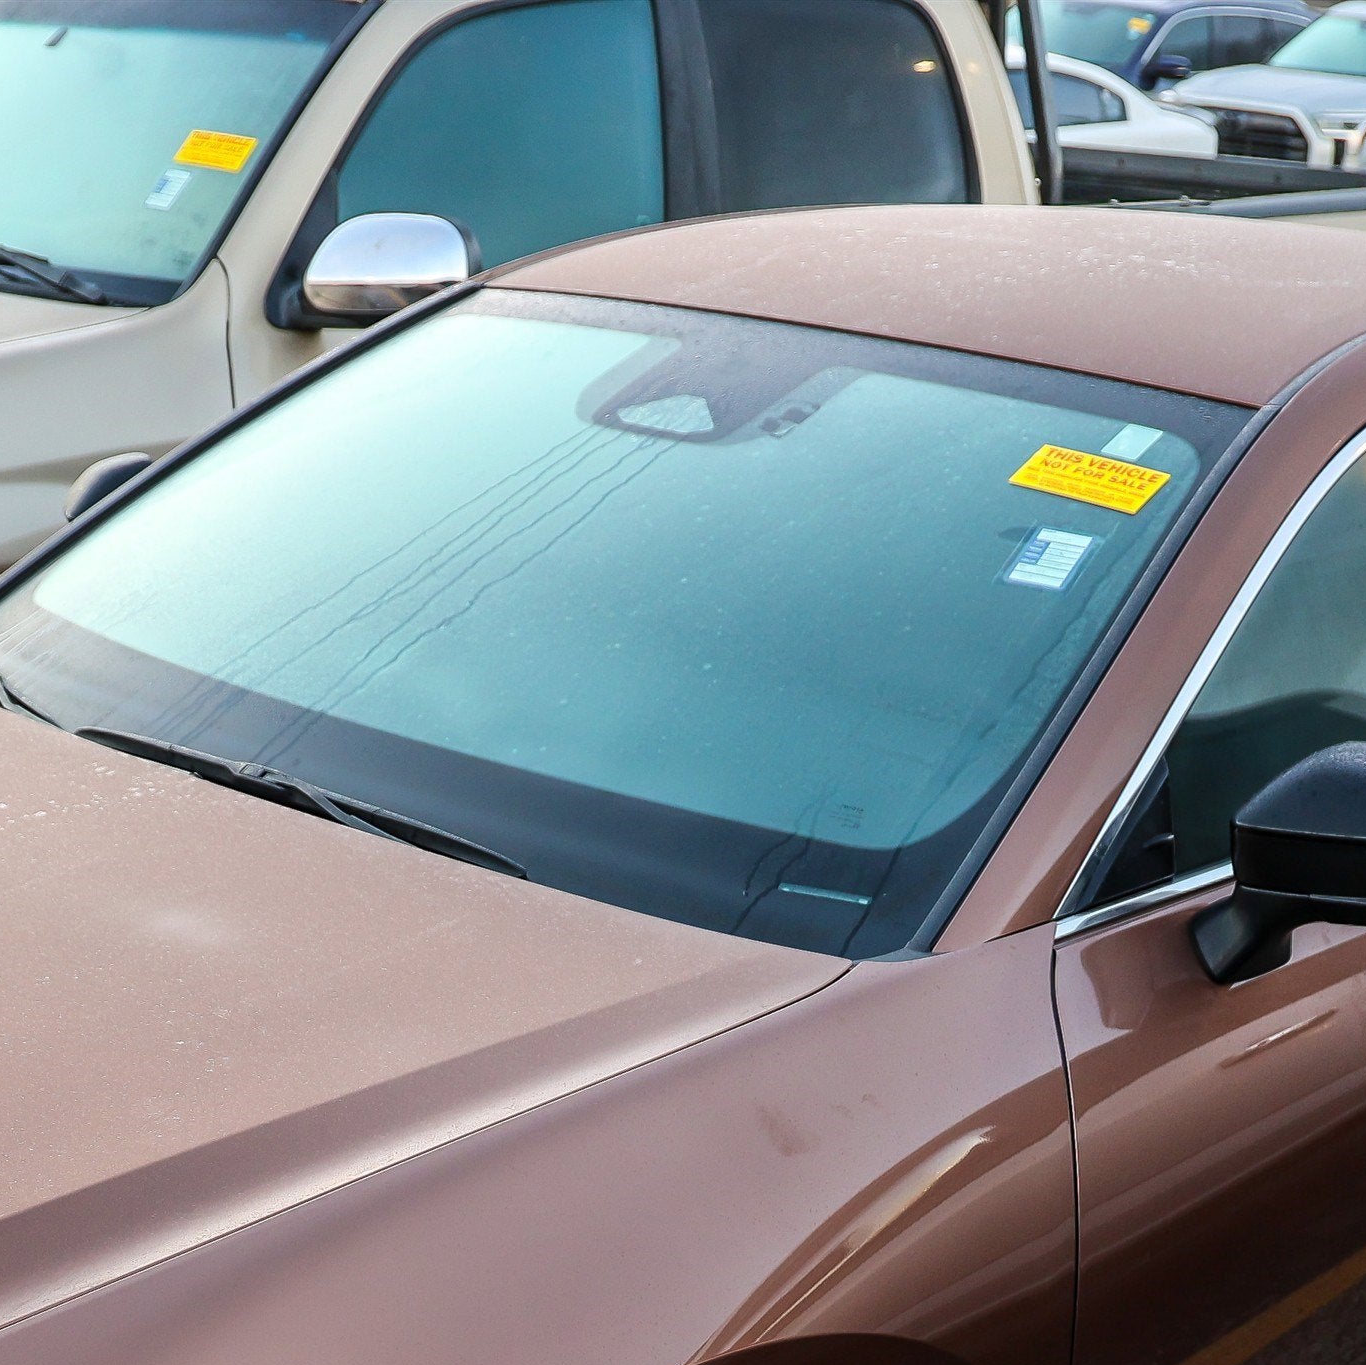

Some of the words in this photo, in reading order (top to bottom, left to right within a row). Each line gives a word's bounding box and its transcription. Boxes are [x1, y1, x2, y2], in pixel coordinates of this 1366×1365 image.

[1040, 458, 1068, 470] NOT
[1073, 466, 1105, 479] FOR
[1108, 474, 1147, 490] SALE
[1046, 447, 1085, 463] THIS
[1088, 457, 1163, 483] VEHICLE
